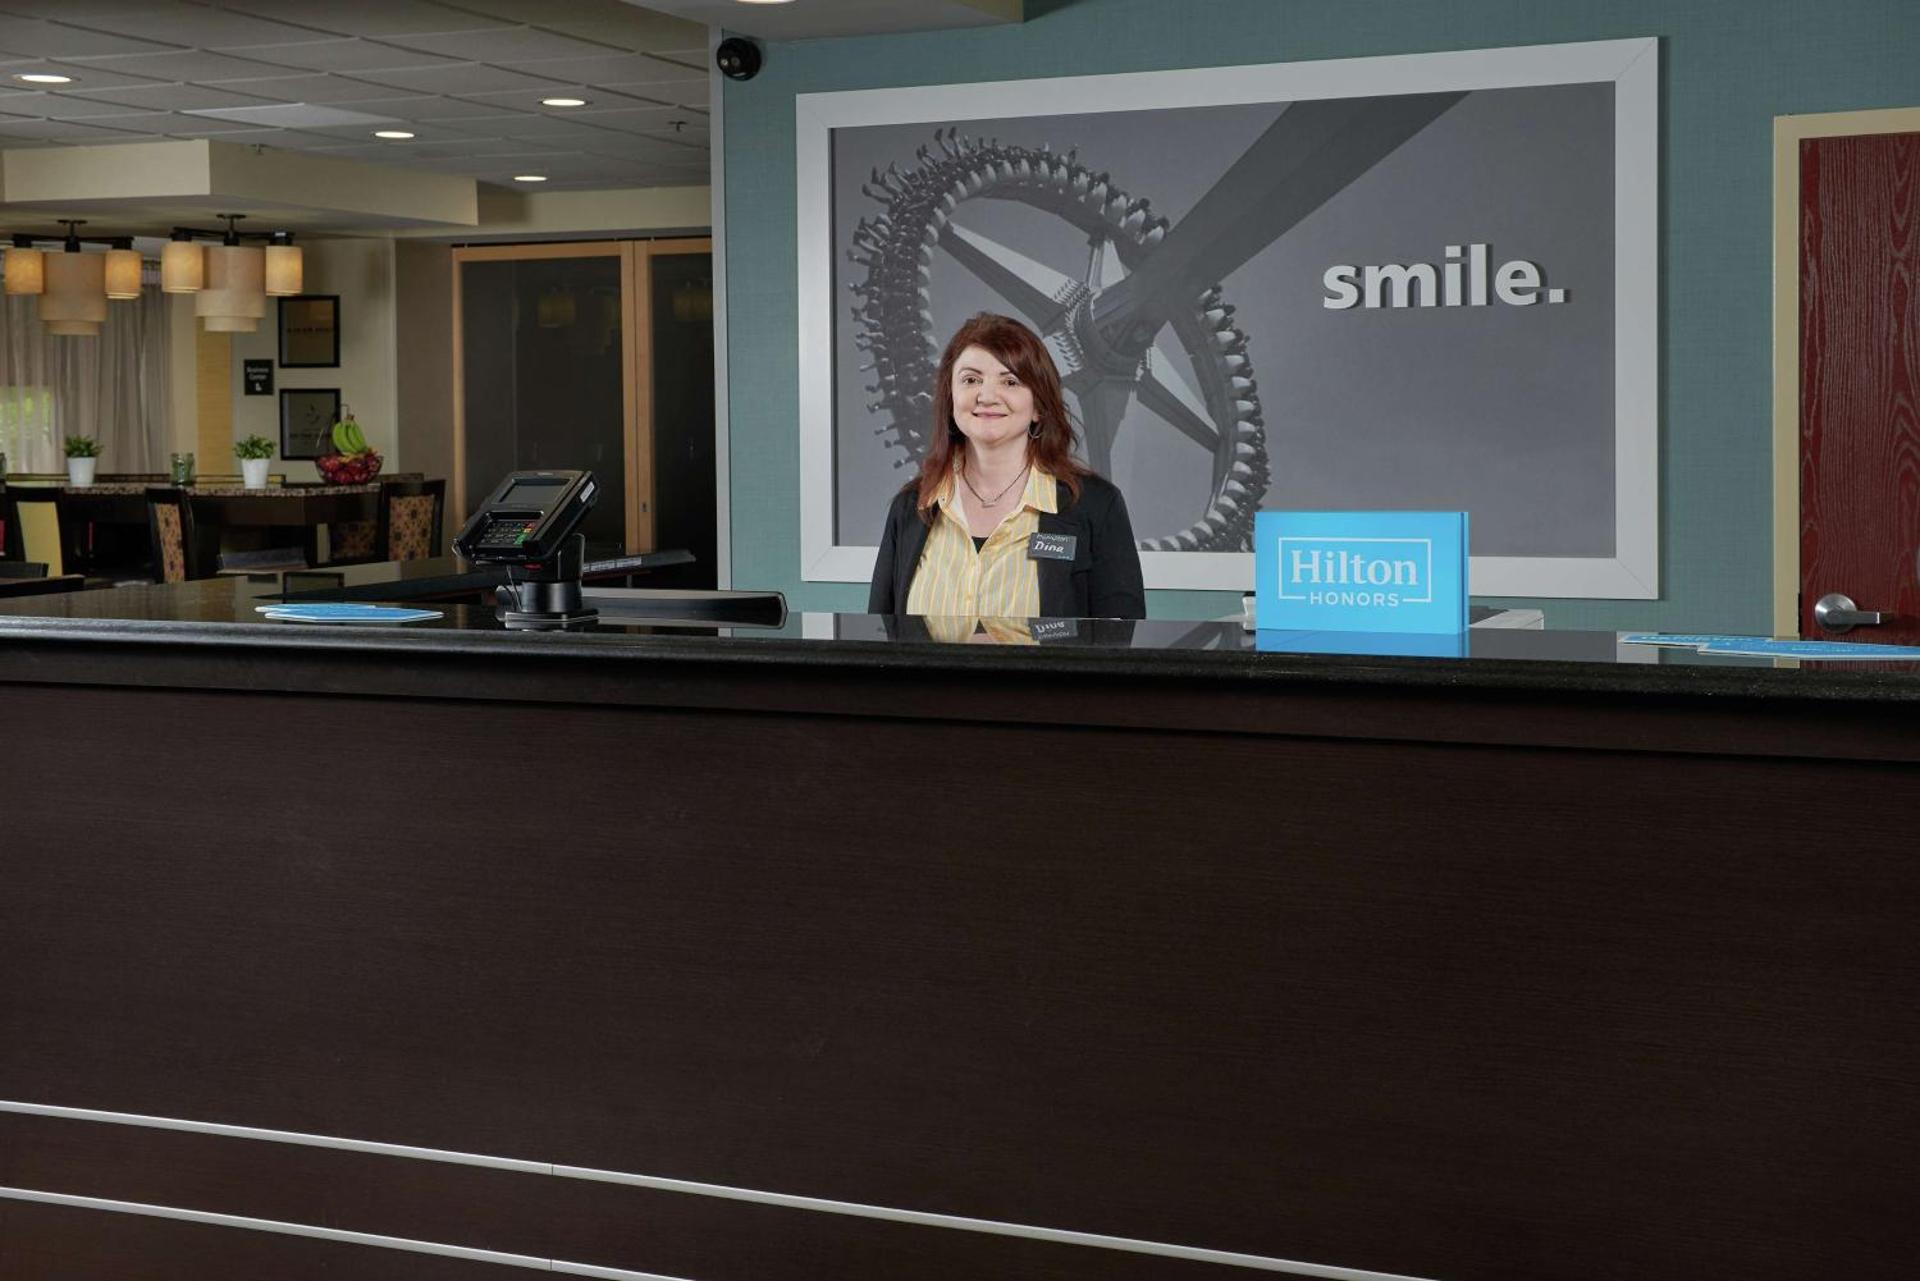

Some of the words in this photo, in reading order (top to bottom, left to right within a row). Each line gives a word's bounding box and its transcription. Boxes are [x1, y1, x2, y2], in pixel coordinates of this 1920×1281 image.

[1323, 243, 1565, 309] smile.
[1034, 541, 1064, 553] Dina
[1291, 550, 1418, 586] Hilton
[1310, 591, 1398, 607] HONORS
